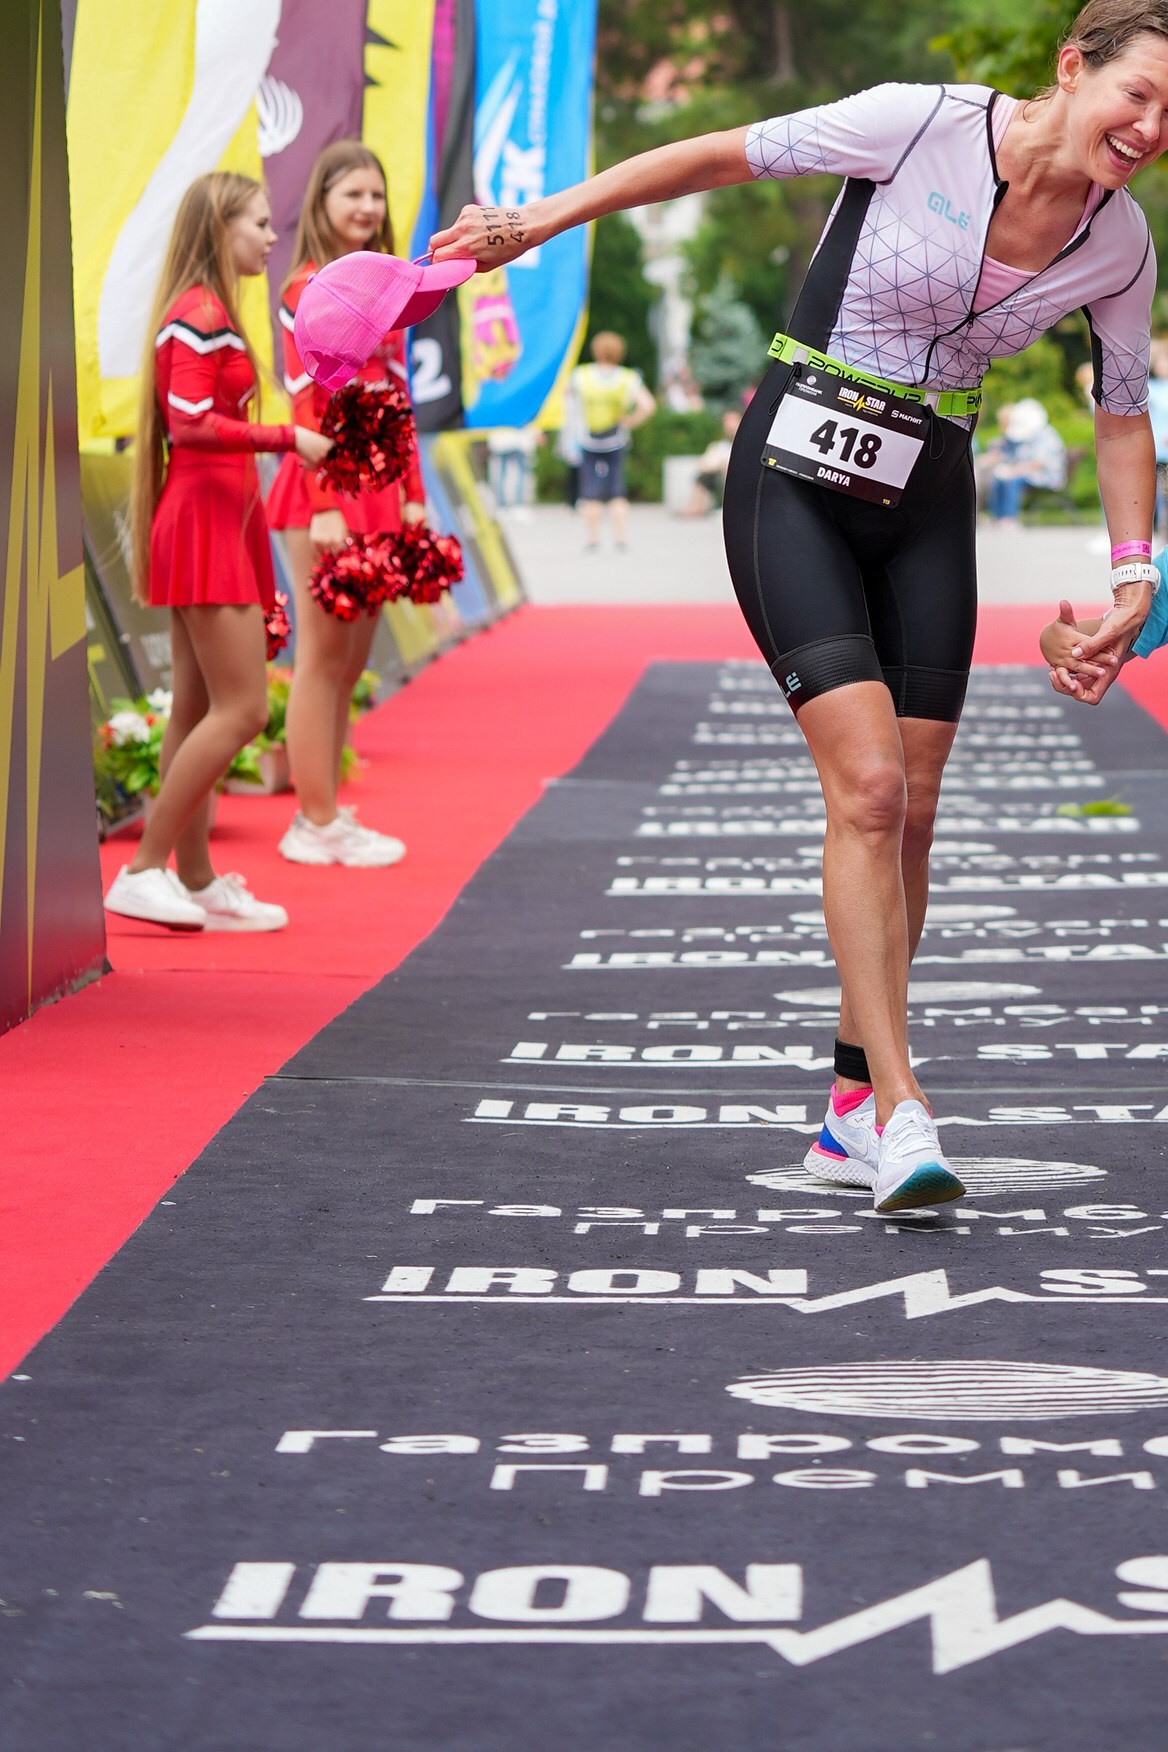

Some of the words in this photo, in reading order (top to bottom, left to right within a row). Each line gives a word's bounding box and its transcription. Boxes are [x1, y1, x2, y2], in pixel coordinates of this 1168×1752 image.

[505, 211, 526, 245] 418
[838, 386, 859, 402] IRON
[865, 394, 887, 412] STAR
[809, 418, 883, 470] 418
[816, 466, 851, 487] DARYA
[510, 1041, 814, 1061] IRON
[474, 1099, 807, 1123] IRON
[381, 1266, 807, 1295] IRON
[211, 1561, 803, 1623] IRON
